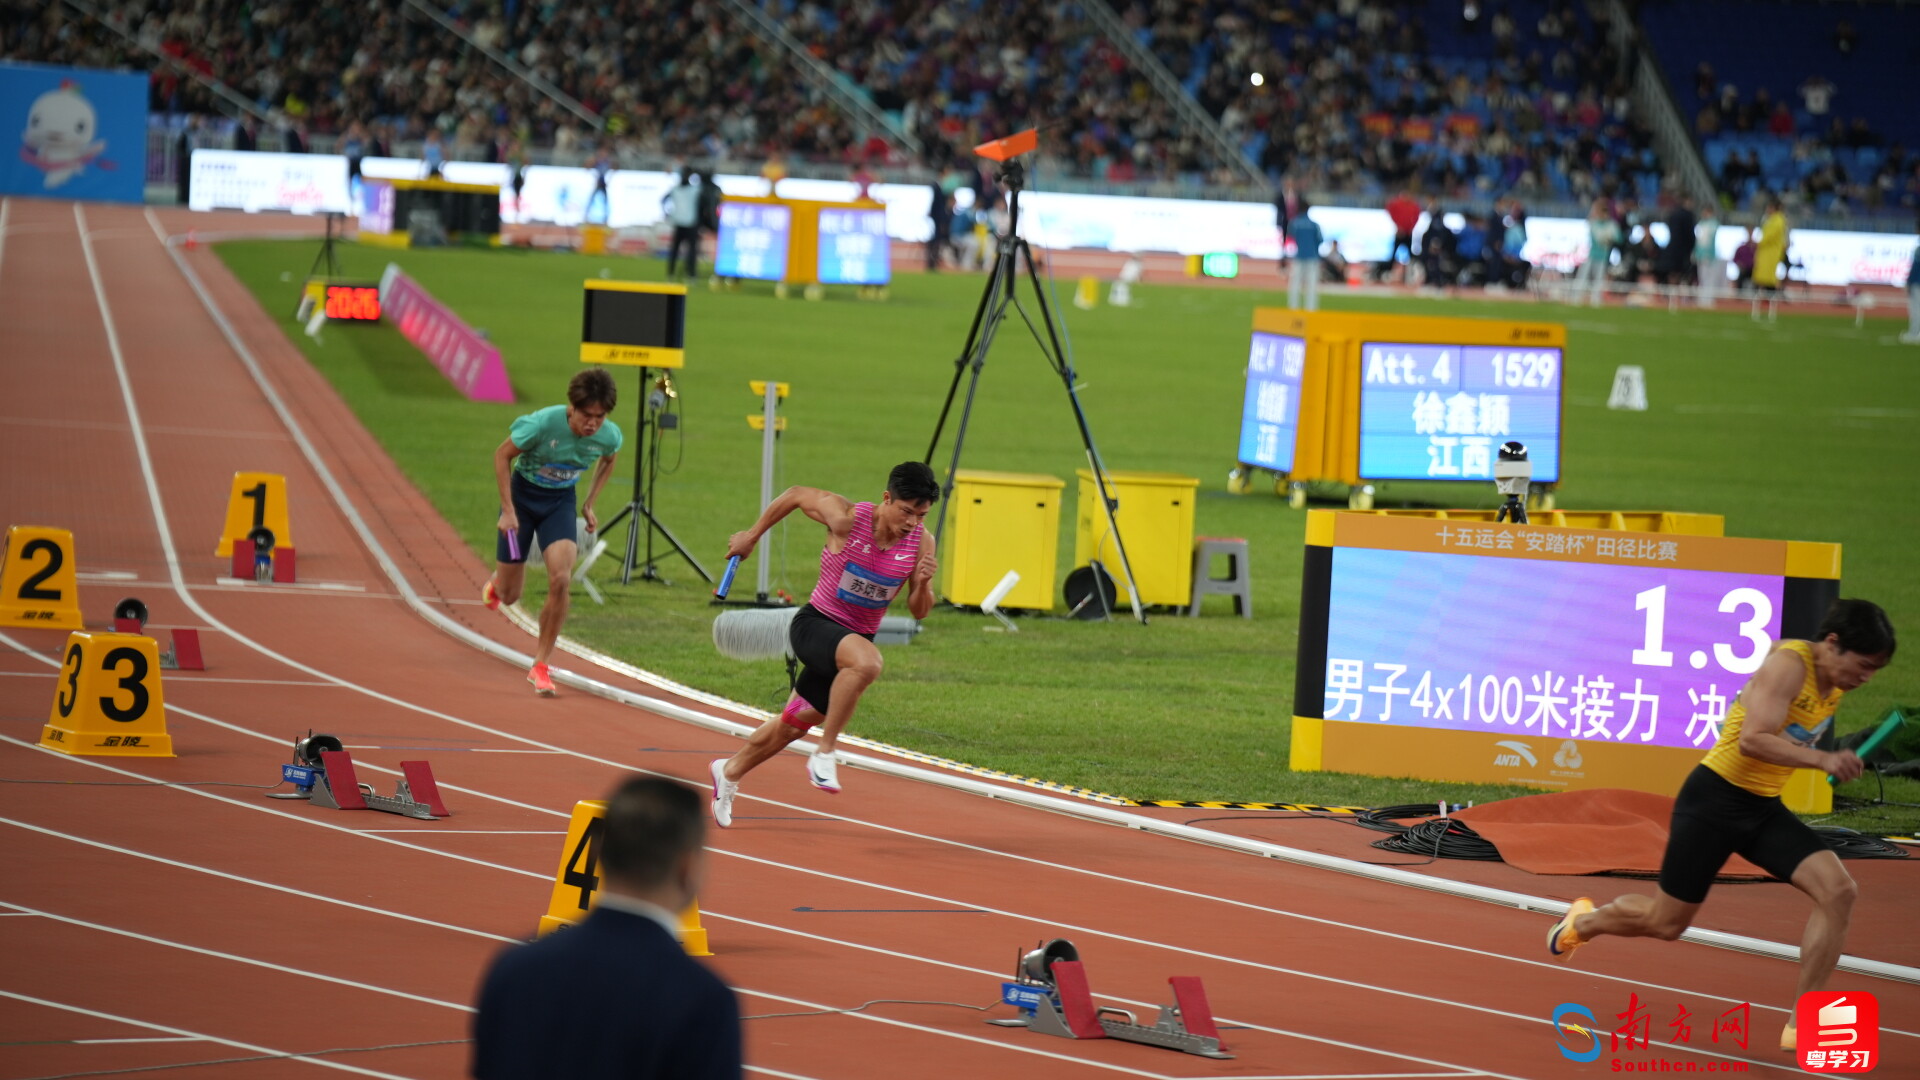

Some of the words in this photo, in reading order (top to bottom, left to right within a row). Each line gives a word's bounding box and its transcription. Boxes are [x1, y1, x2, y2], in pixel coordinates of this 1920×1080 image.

[1491, 352, 1556, 388] 1529
[1427, 435, 1492, 478] 江西
[242, 482, 266, 526] 1
[17, 538, 63, 600] 2
[1435, 525, 1679, 562] 十五运会“安踏杯”田径比赛
[1632, 584, 1773, 674] 1.3
[58, 643, 82, 718] 3
[99, 647, 149, 722] 3
[1323, 658, 1660, 742] 男子4x100米接力
[1684, 683, 1742, 747] 决
[1493, 754, 1520, 767] ANTA
[563, 816, 602, 911] 4
